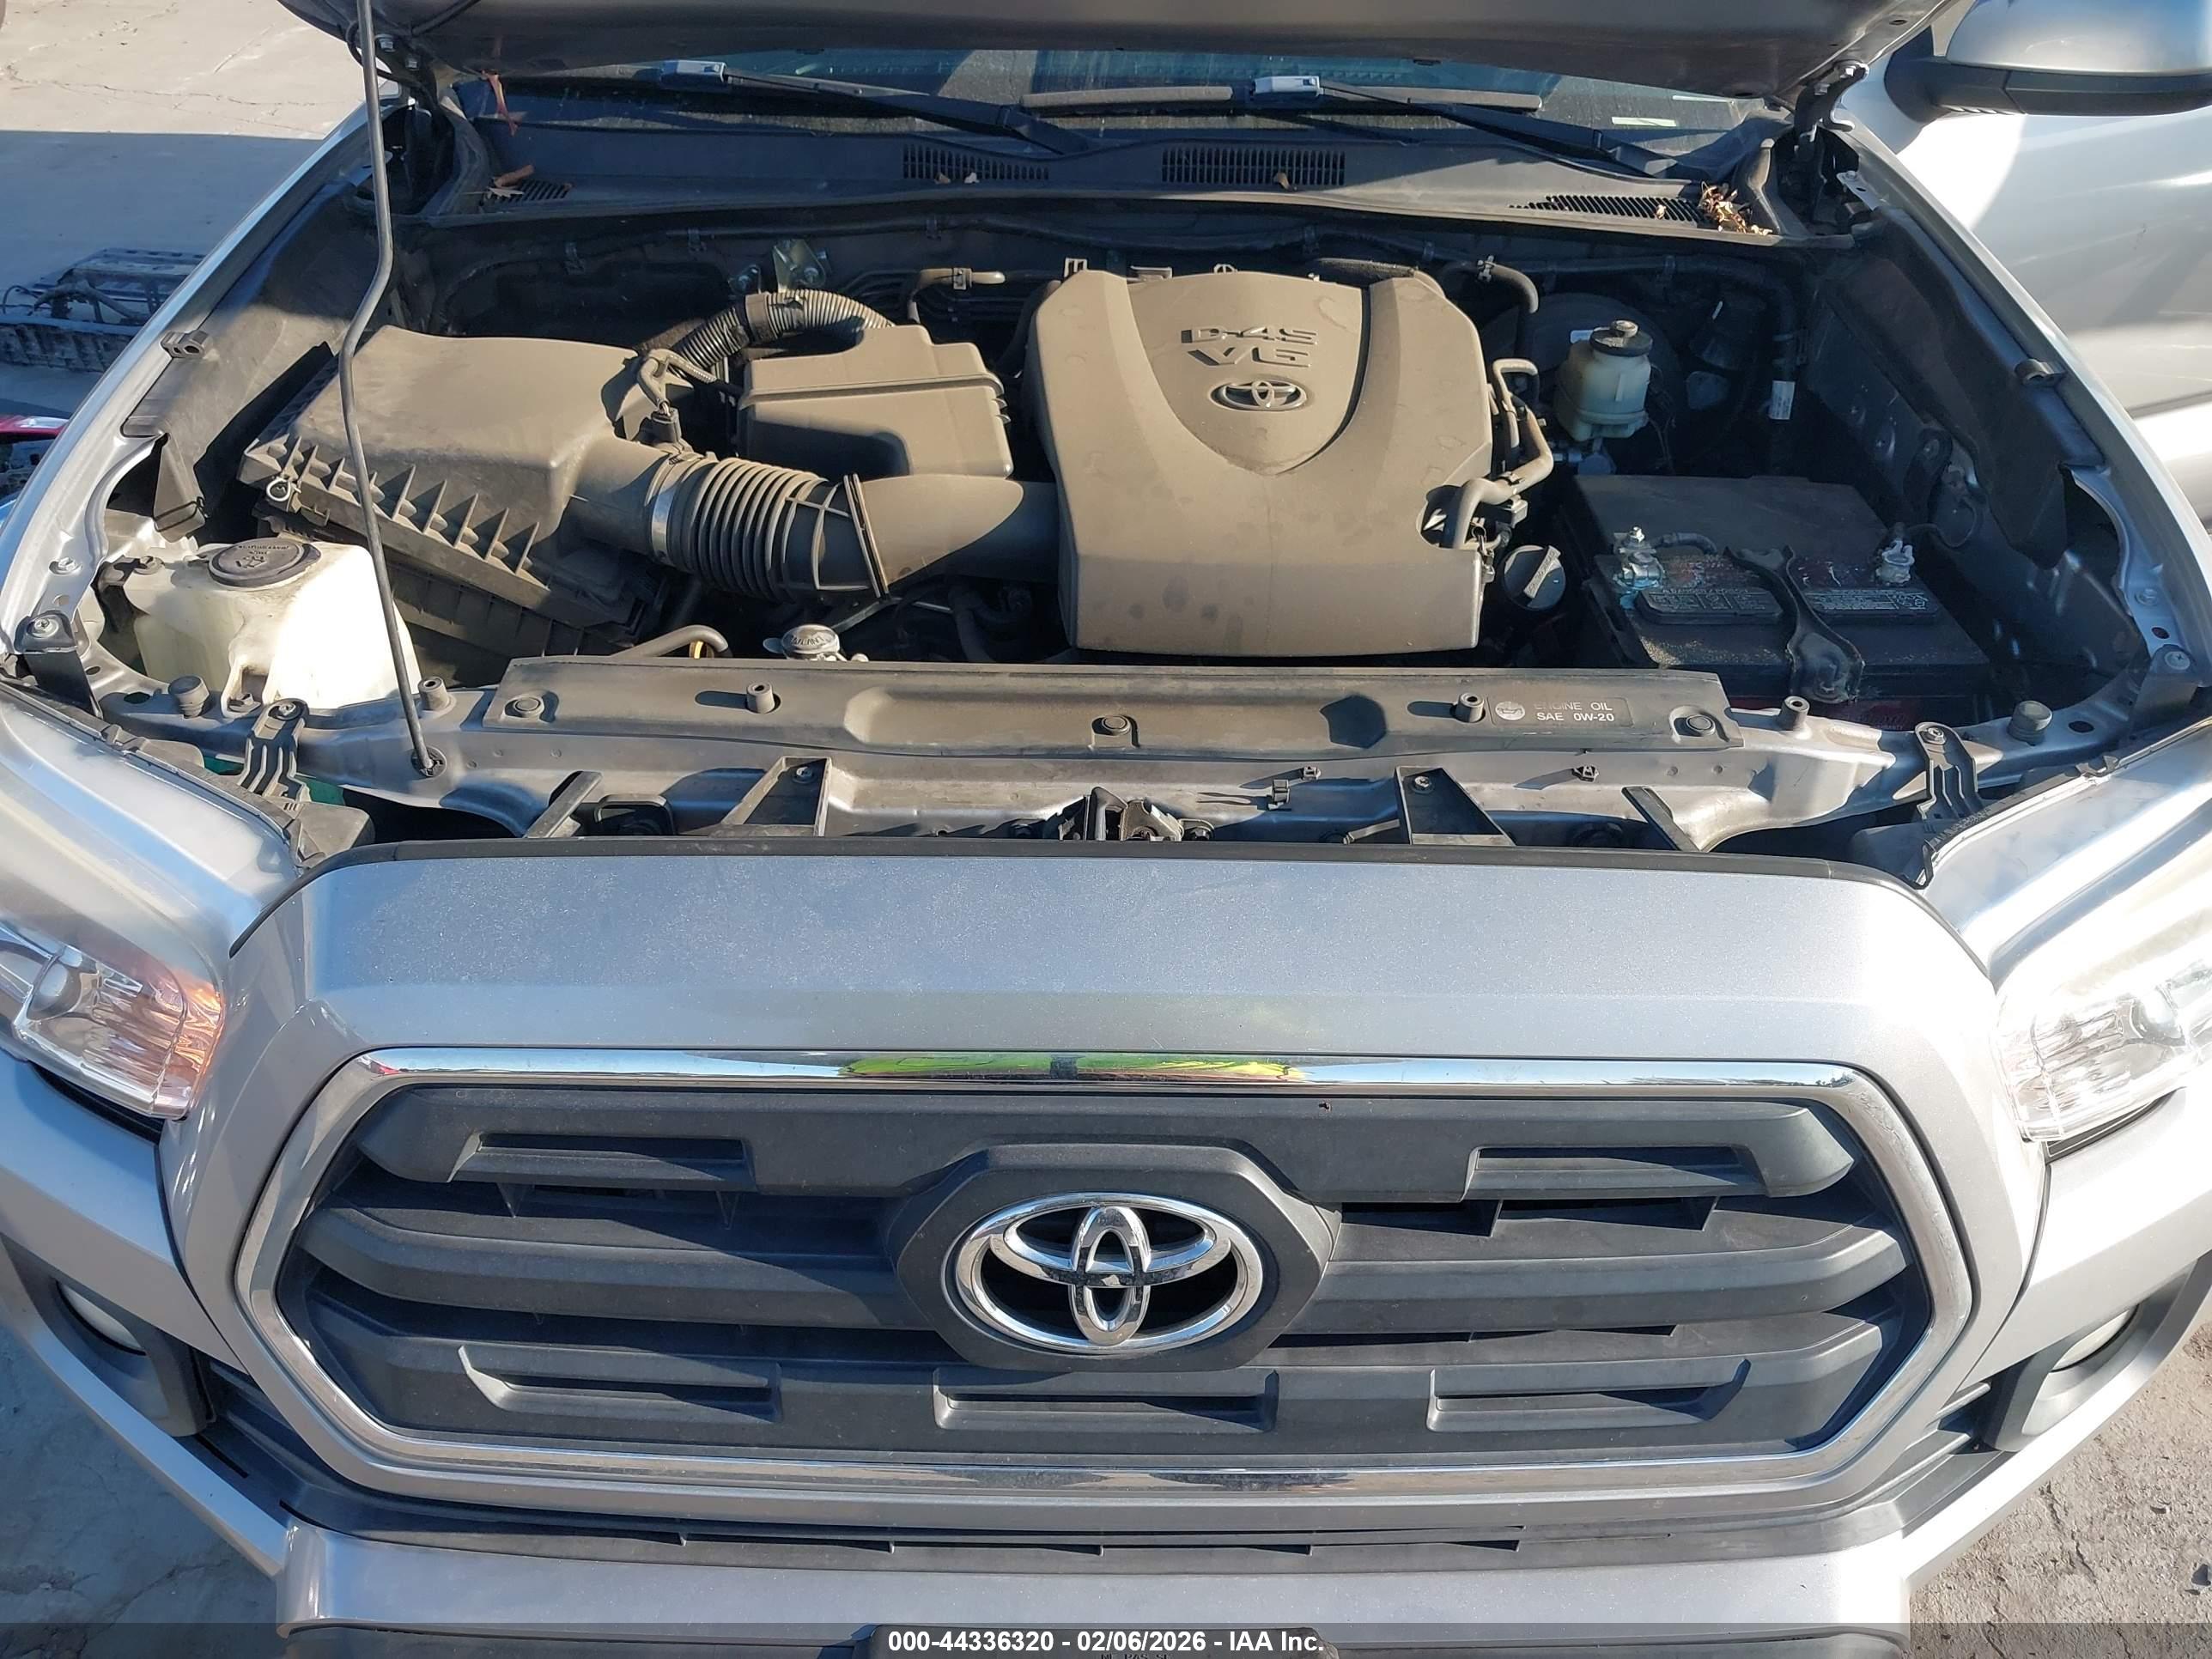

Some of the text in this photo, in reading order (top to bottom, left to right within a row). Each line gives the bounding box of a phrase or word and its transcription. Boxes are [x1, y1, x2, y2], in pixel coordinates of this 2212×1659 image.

[1181, 325, 1318, 345] D-4S
[1187, 346, 1312, 368] V6
[1590, 702, 1613, 711] OIL
[1536, 712, 1614, 722] SAE 0W-20
